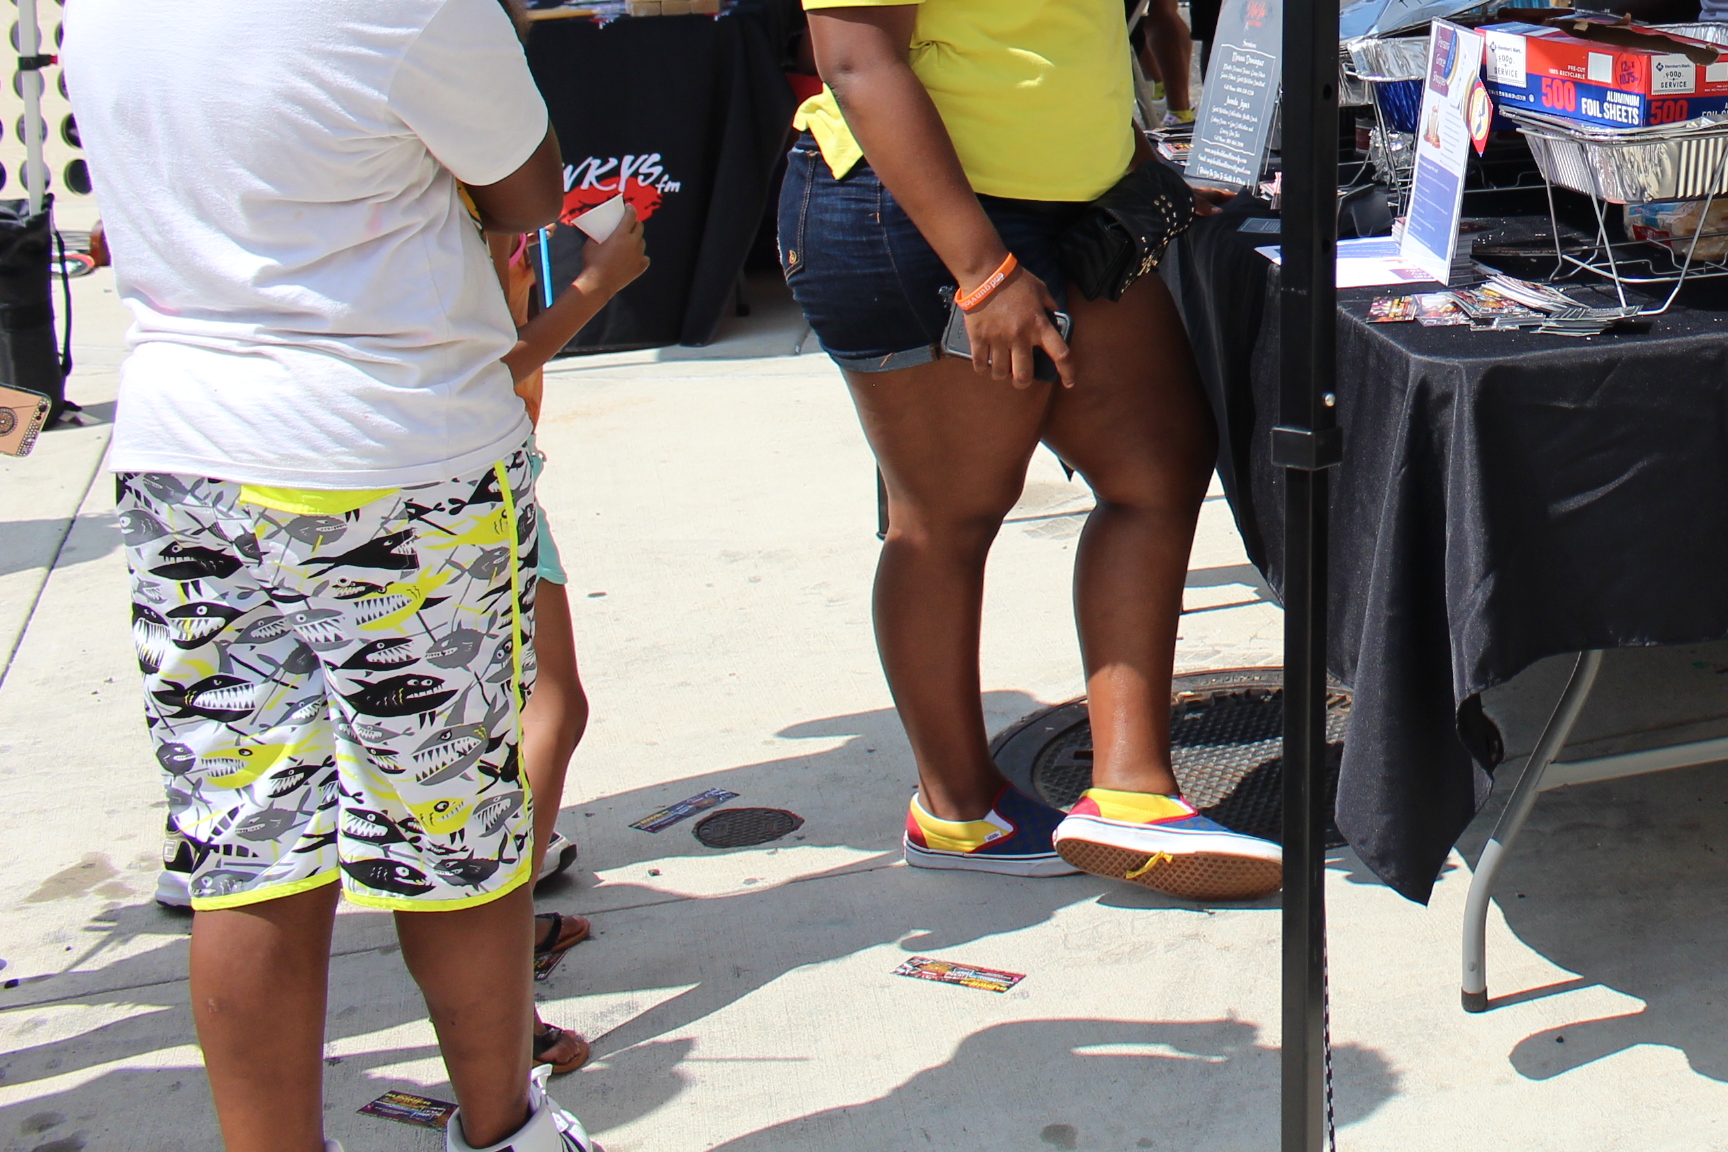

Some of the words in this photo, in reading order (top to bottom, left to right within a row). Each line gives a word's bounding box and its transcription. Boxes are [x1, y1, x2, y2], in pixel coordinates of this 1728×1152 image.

[1498, 55, 1513, 64] FOOD
[1494, 67, 1518, 78] SERVICE
[1560, 70, 1586, 80] RECYCLABLE
[1568, 65, 1586, 73] PRE-CUT
[1665, 70, 1682, 78] FOOD
[1541, 77, 1577, 112] 500
[1606, 90, 1640, 108] ALUMINUM
[1581, 97, 1602, 118] FOIL
[1603, 101, 1640, 126] SHEETS
[1649, 99, 1689, 125] 500
[655, 172, 681, 194] fm
[975, 285, 991, 299] gun
